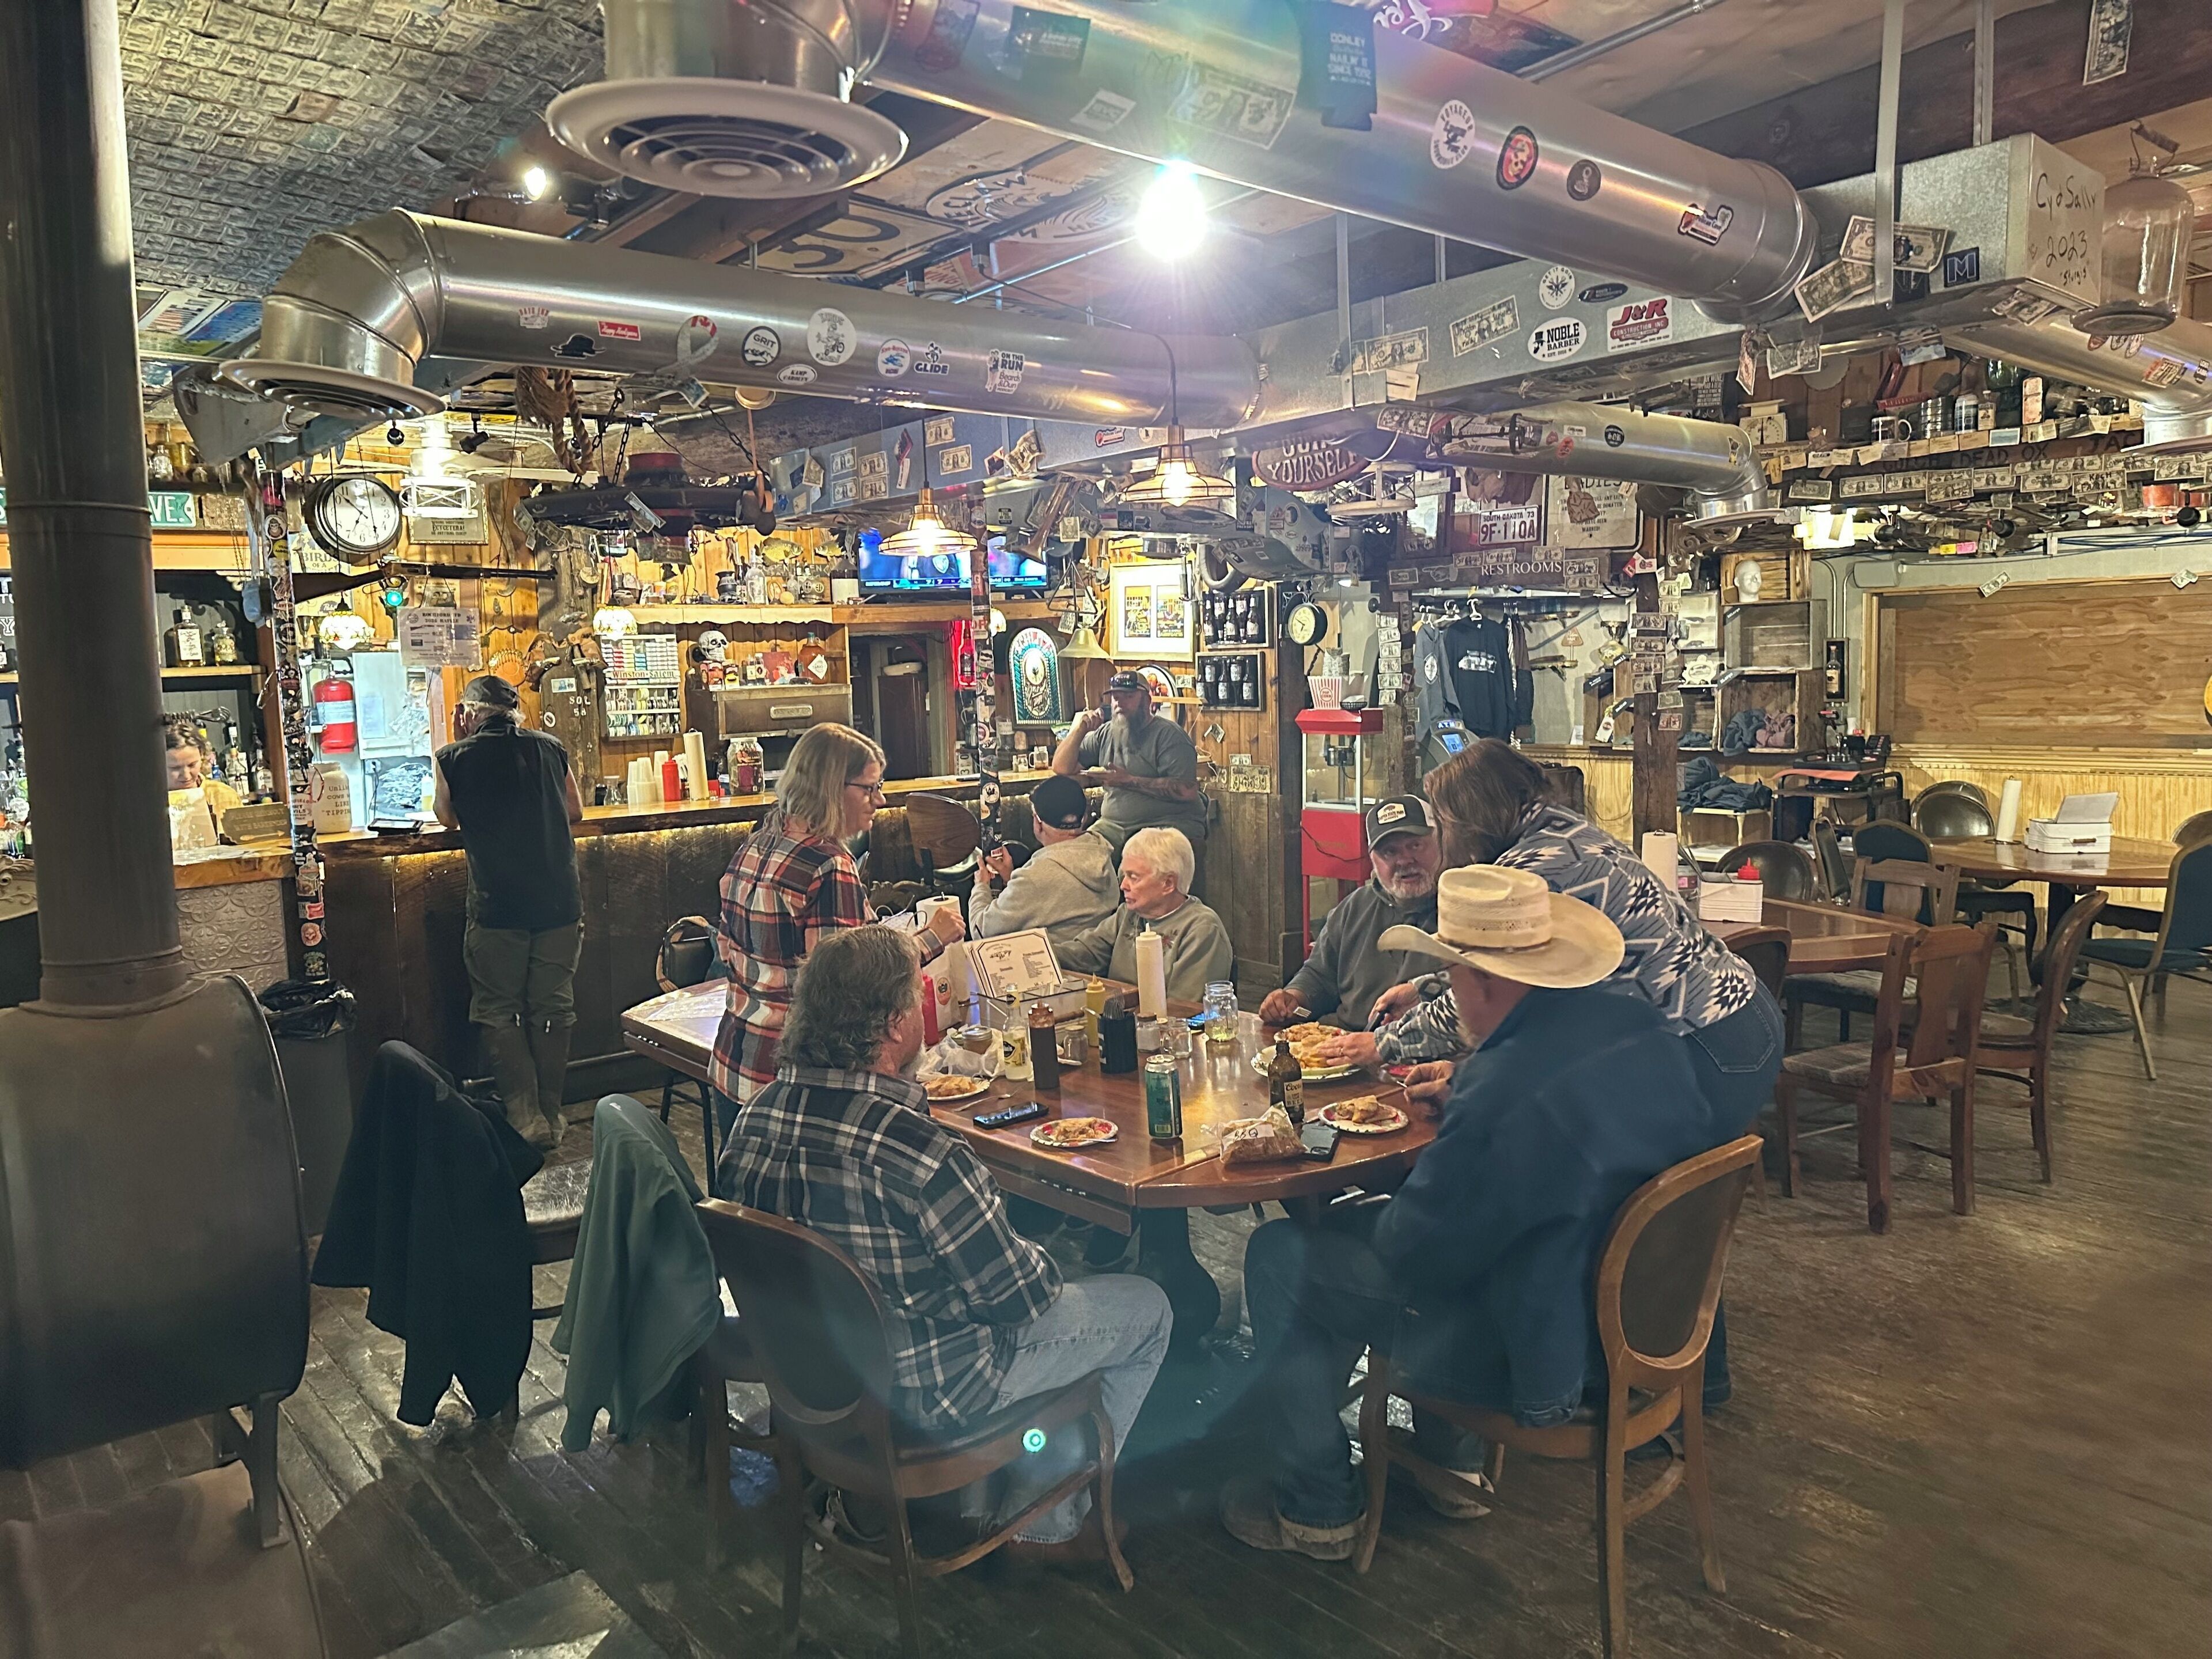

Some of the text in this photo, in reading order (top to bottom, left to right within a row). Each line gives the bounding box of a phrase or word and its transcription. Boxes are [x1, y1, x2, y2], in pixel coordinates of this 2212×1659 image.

[2046, 230, 2088, 267] 2023
[1612, 298, 1668, 327] J&R
[1547, 323, 1580, 343] NOBLE
[1613, 323, 1652, 337] CONSTRUCTION
[753, 334, 777, 348] GRIT
[1547, 338, 1580, 351] BARBER
[915, 363, 948, 374] GLIDE
[1001, 359, 1024, 372] RUN
[1960, 448, 2009, 466] DEAD
[2021, 443, 2050, 460] OX
[1483, 514, 1501, 522] SOUTH
[1502, 512, 1524, 521] DAKOTA
[1482, 560, 1562, 576] RESTROOMS
[1437, 721, 1456, 729] ATM
[1234, 1127, 1259, 1142] BBQ
